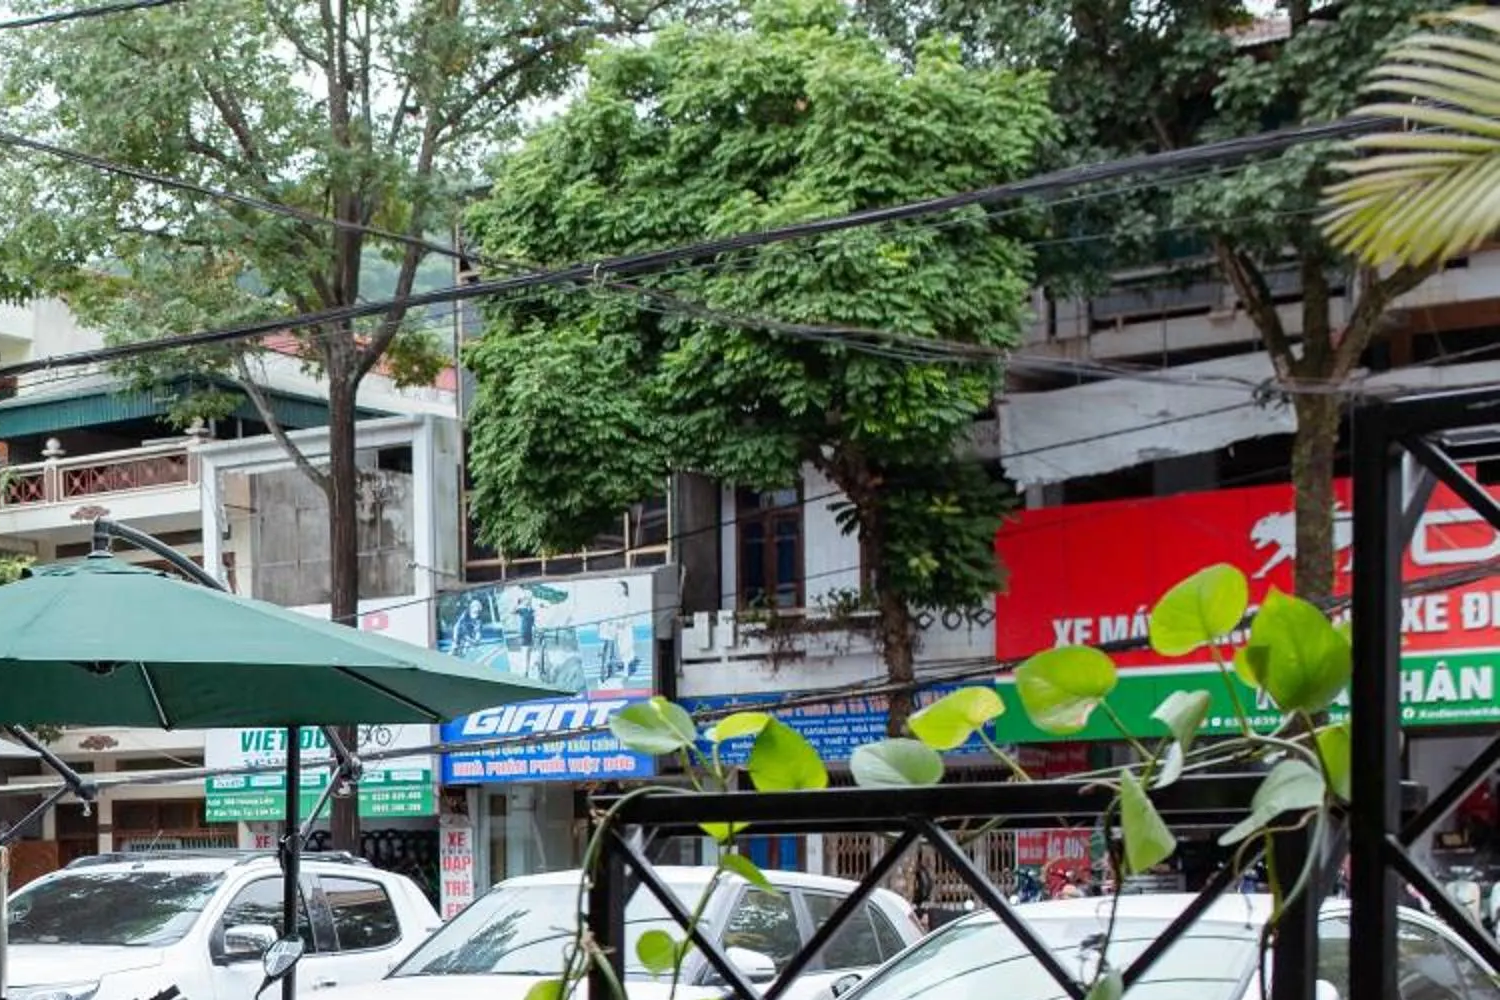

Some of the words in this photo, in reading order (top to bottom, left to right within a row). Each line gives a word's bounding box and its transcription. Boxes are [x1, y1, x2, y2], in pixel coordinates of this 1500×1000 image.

[1052, 617, 1093, 648] XE
[1099, 604, 1153, 643] MÁ
[1401, 597, 1449, 632] XE
[462, 699, 629, 736] GIANT
[255, 834, 271, 849] XE
[446, 831, 467, 847] XE
